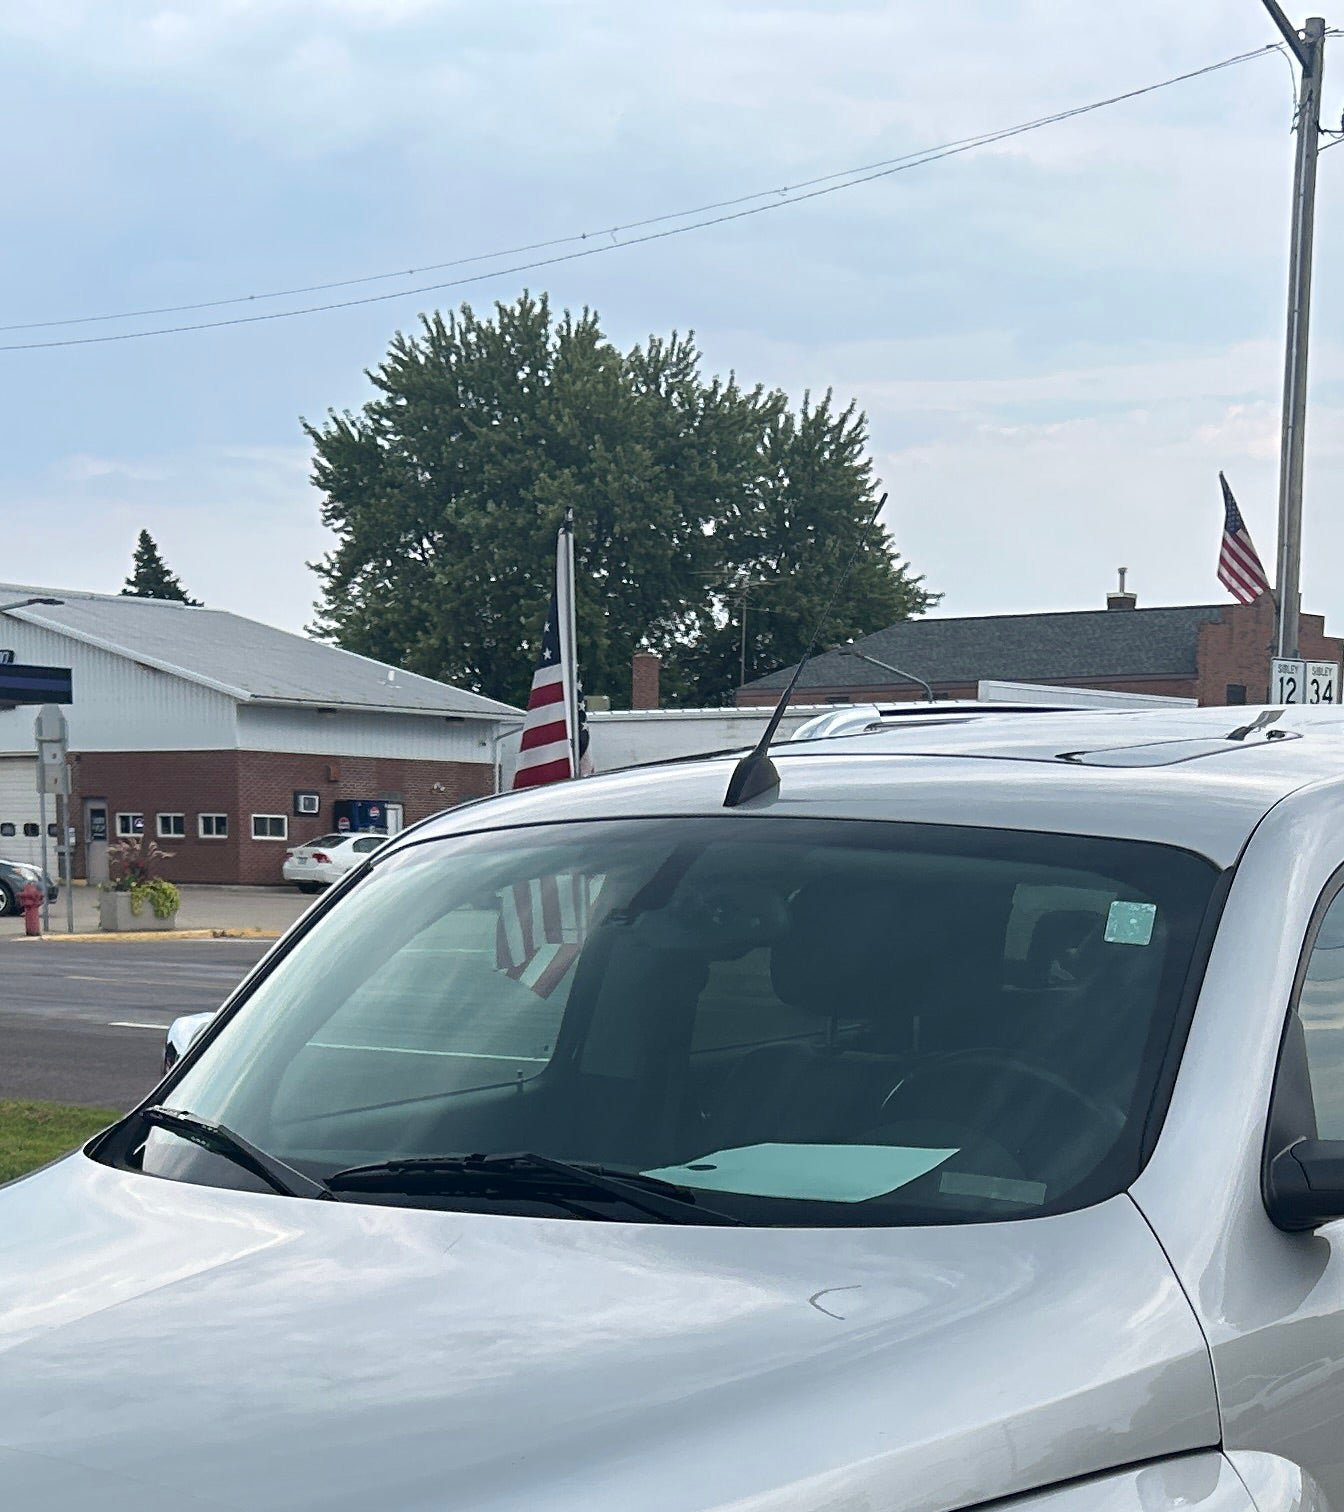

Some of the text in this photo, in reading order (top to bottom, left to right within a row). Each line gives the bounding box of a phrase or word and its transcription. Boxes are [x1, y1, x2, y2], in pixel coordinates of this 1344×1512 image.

[1277, 663, 1299, 675] SIBLEY
[1311, 665, 1333, 677] SIBLEY
[1279, 676, 1297, 704] 12
[1309, 678, 1333, 704] 34
